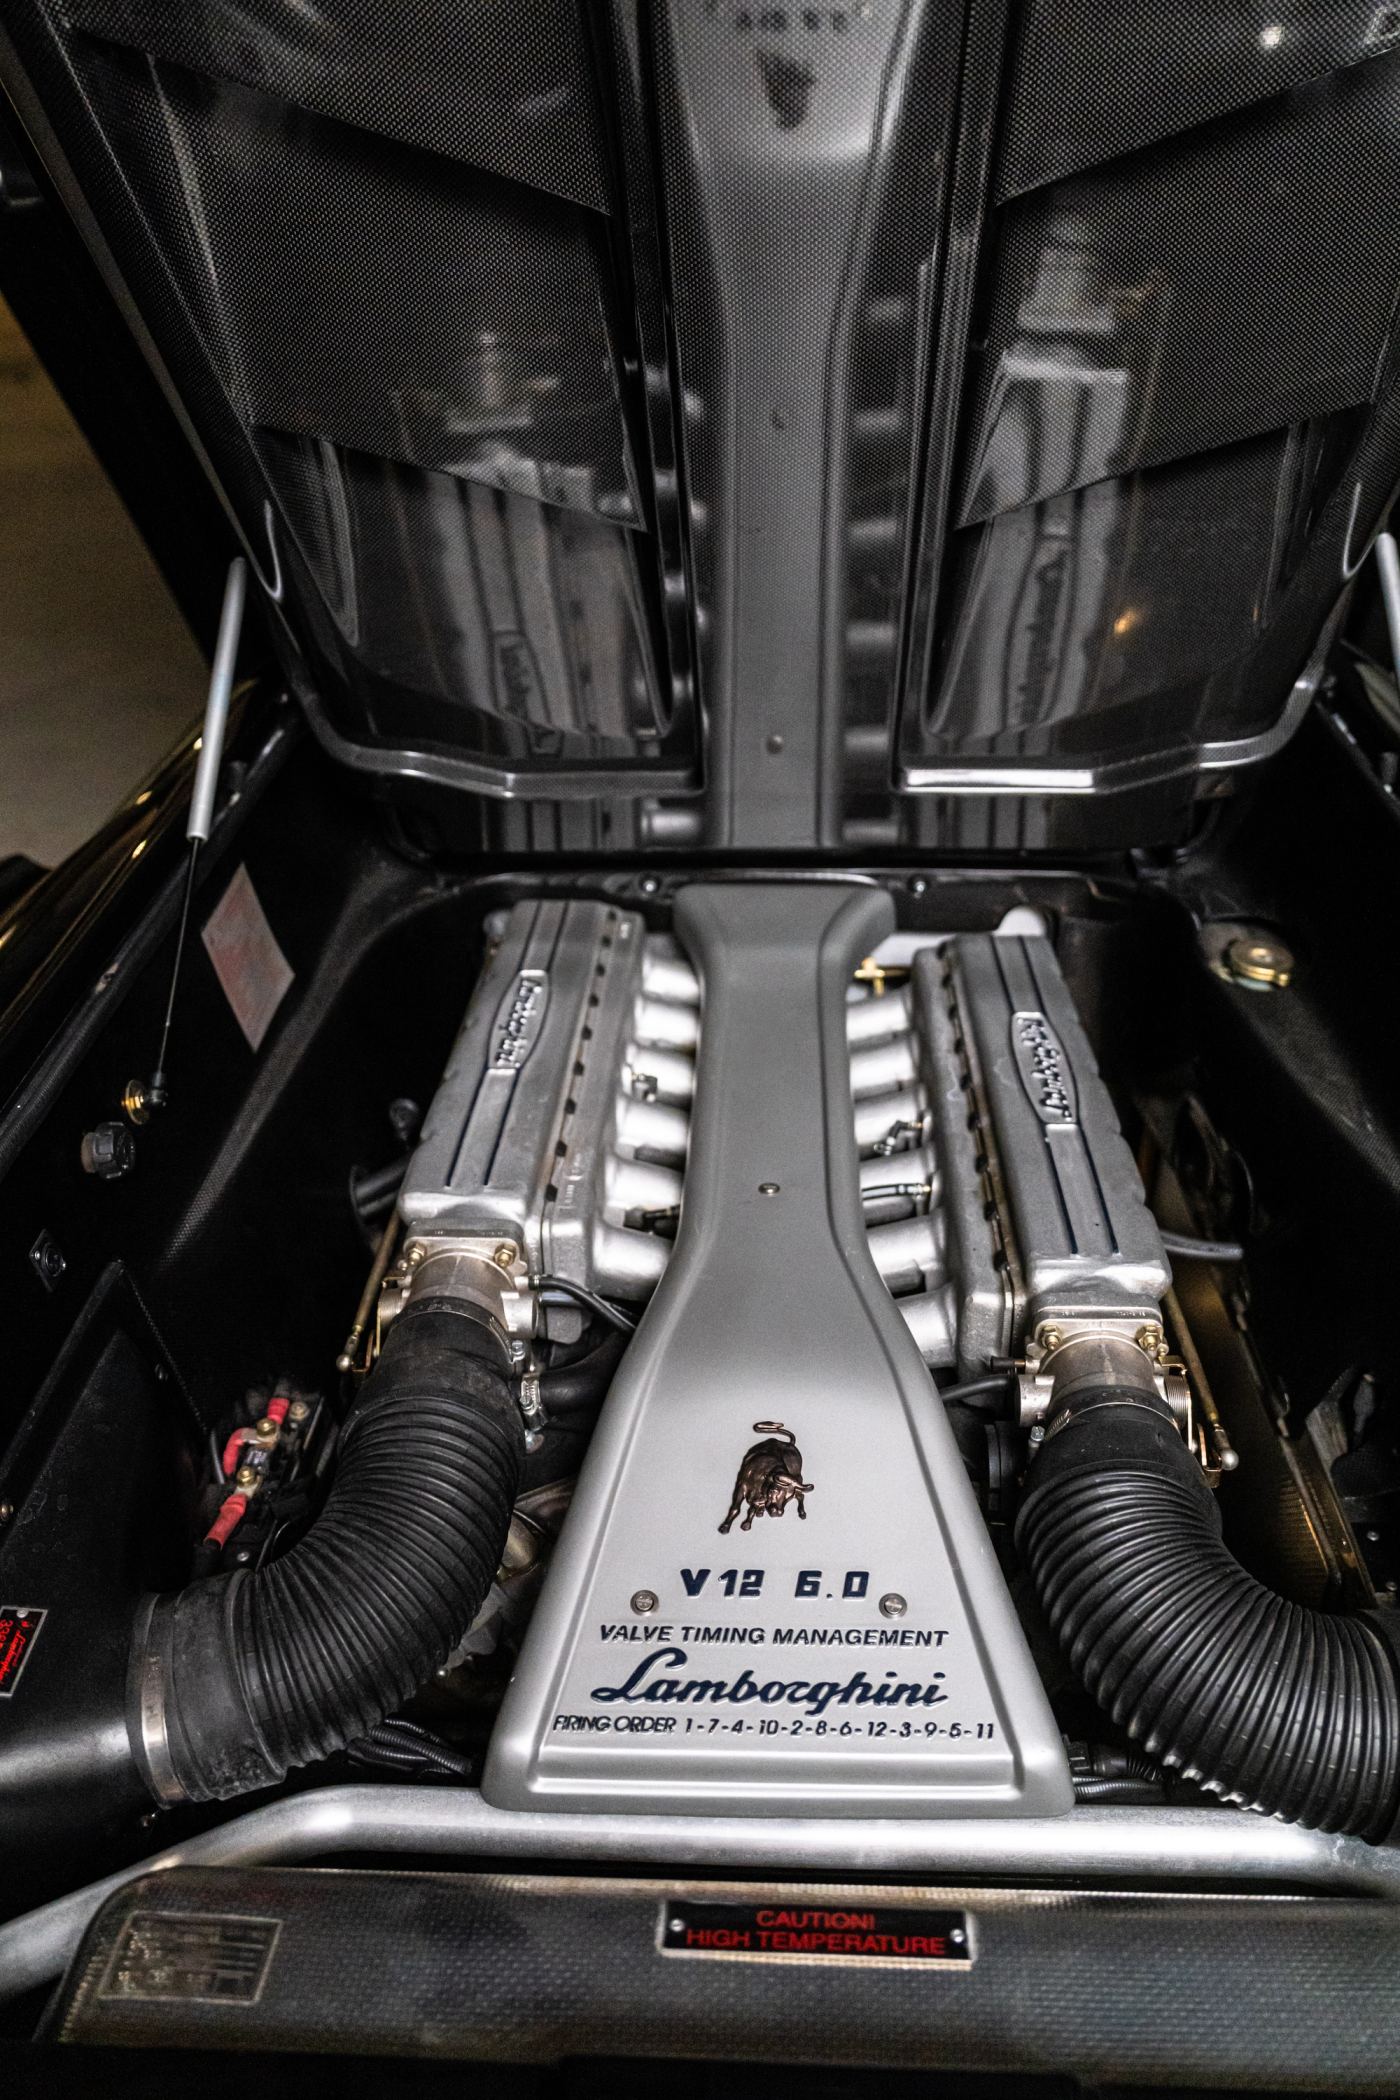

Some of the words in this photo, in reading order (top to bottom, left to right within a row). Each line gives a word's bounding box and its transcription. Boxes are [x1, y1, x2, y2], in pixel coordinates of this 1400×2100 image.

[795, 1570, 870, 1599] 6.0
[600, 1625, 674, 1644] VALVE
[681, 1627, 765, 1645] TIMING
[773, 1629, 949, 1648] MANAGEMENT
[590, 1647, 948, 1717] Lamborghini
[552, 1714, 612, 1732] FIRING
[614, 1716, 677, 1734] ORDER
[686, 1928, 750, 1948] HIGH
[756, 1931, 946, 1955] TEMPERATURE
